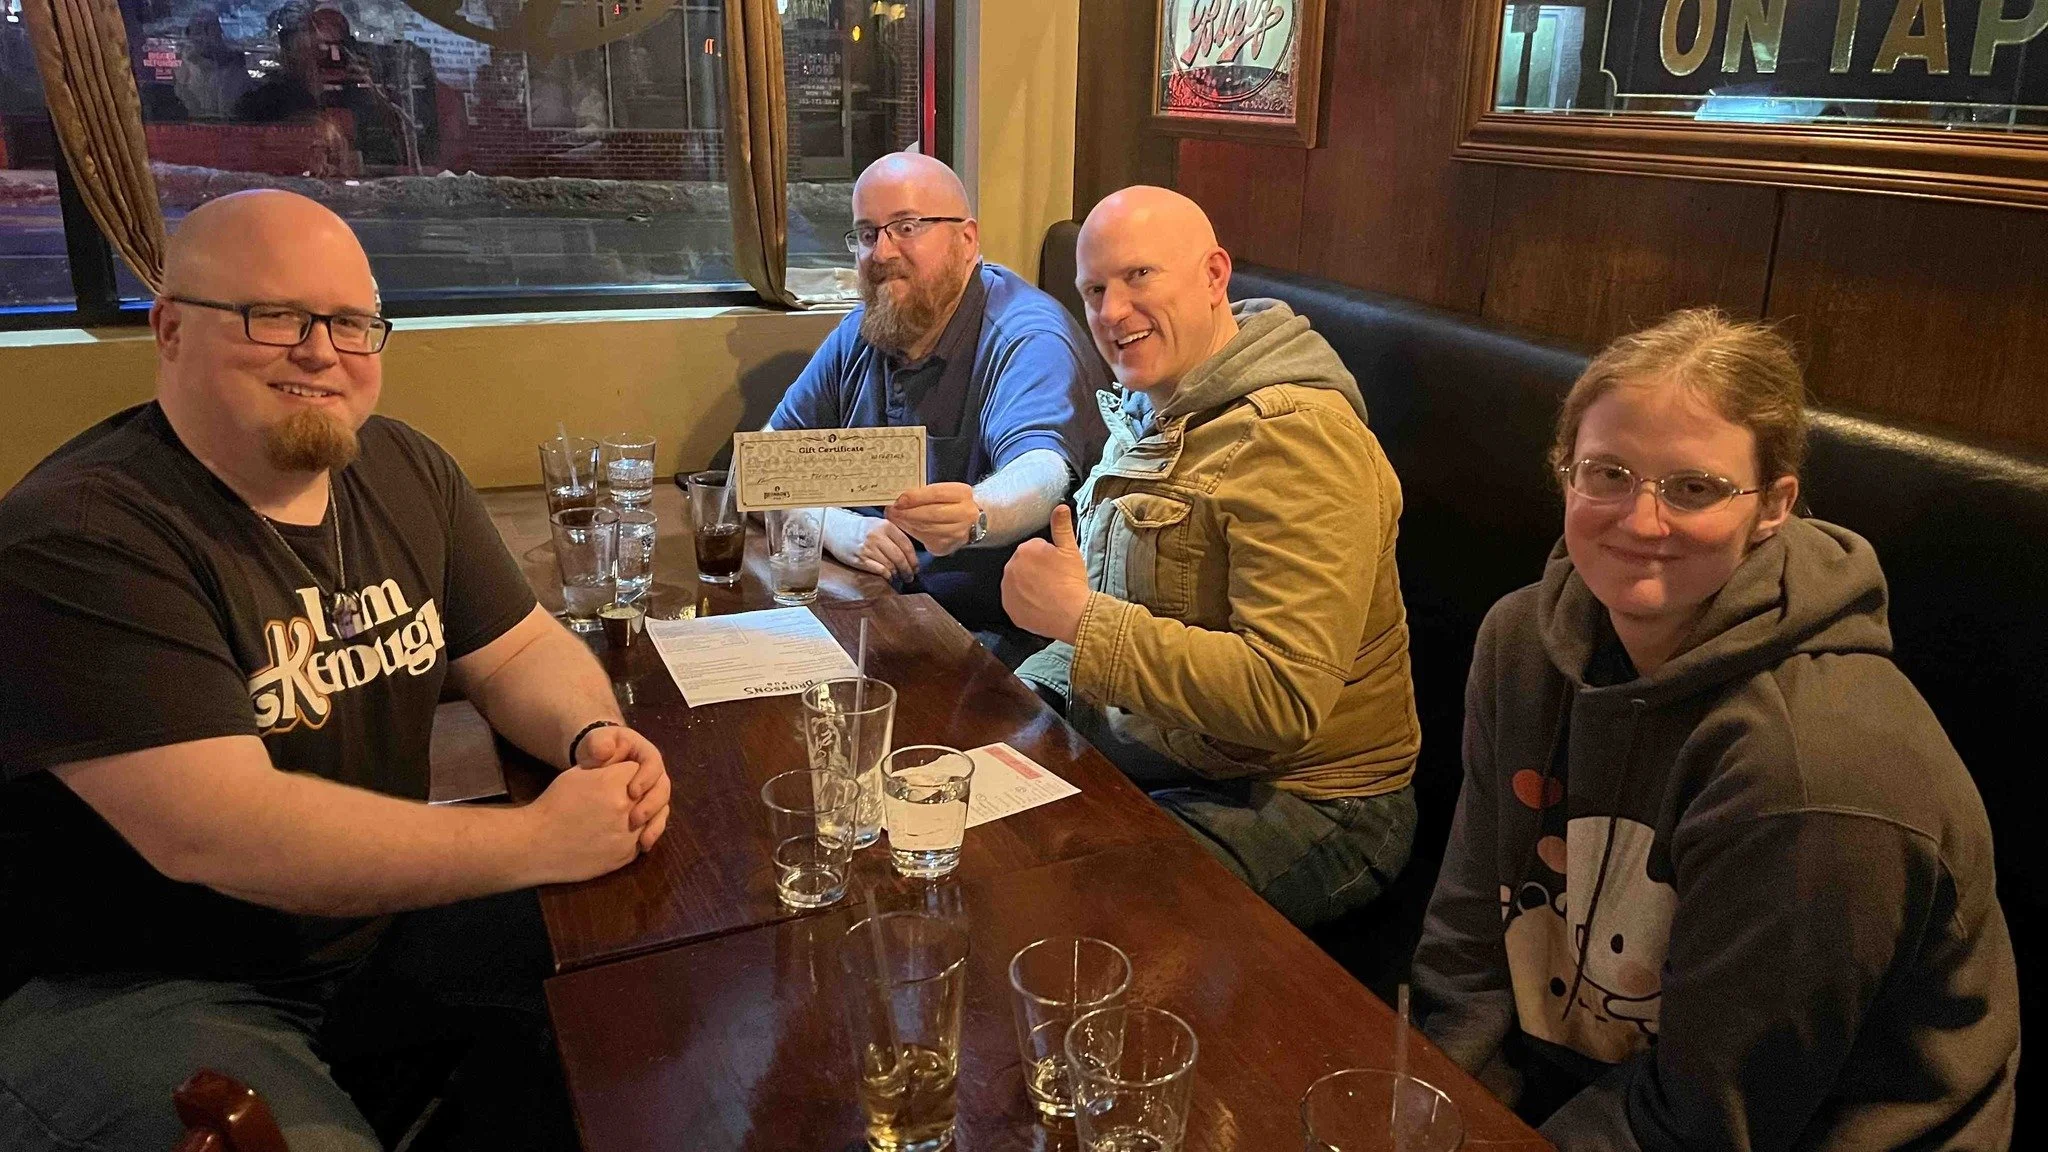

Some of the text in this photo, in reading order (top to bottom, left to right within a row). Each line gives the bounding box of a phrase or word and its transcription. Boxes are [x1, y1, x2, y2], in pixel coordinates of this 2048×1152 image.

[1660, 0, 1786, 76] ON
[799, 445, 864, 454] Gift Certificate
[295, 586, 334, 642] I
